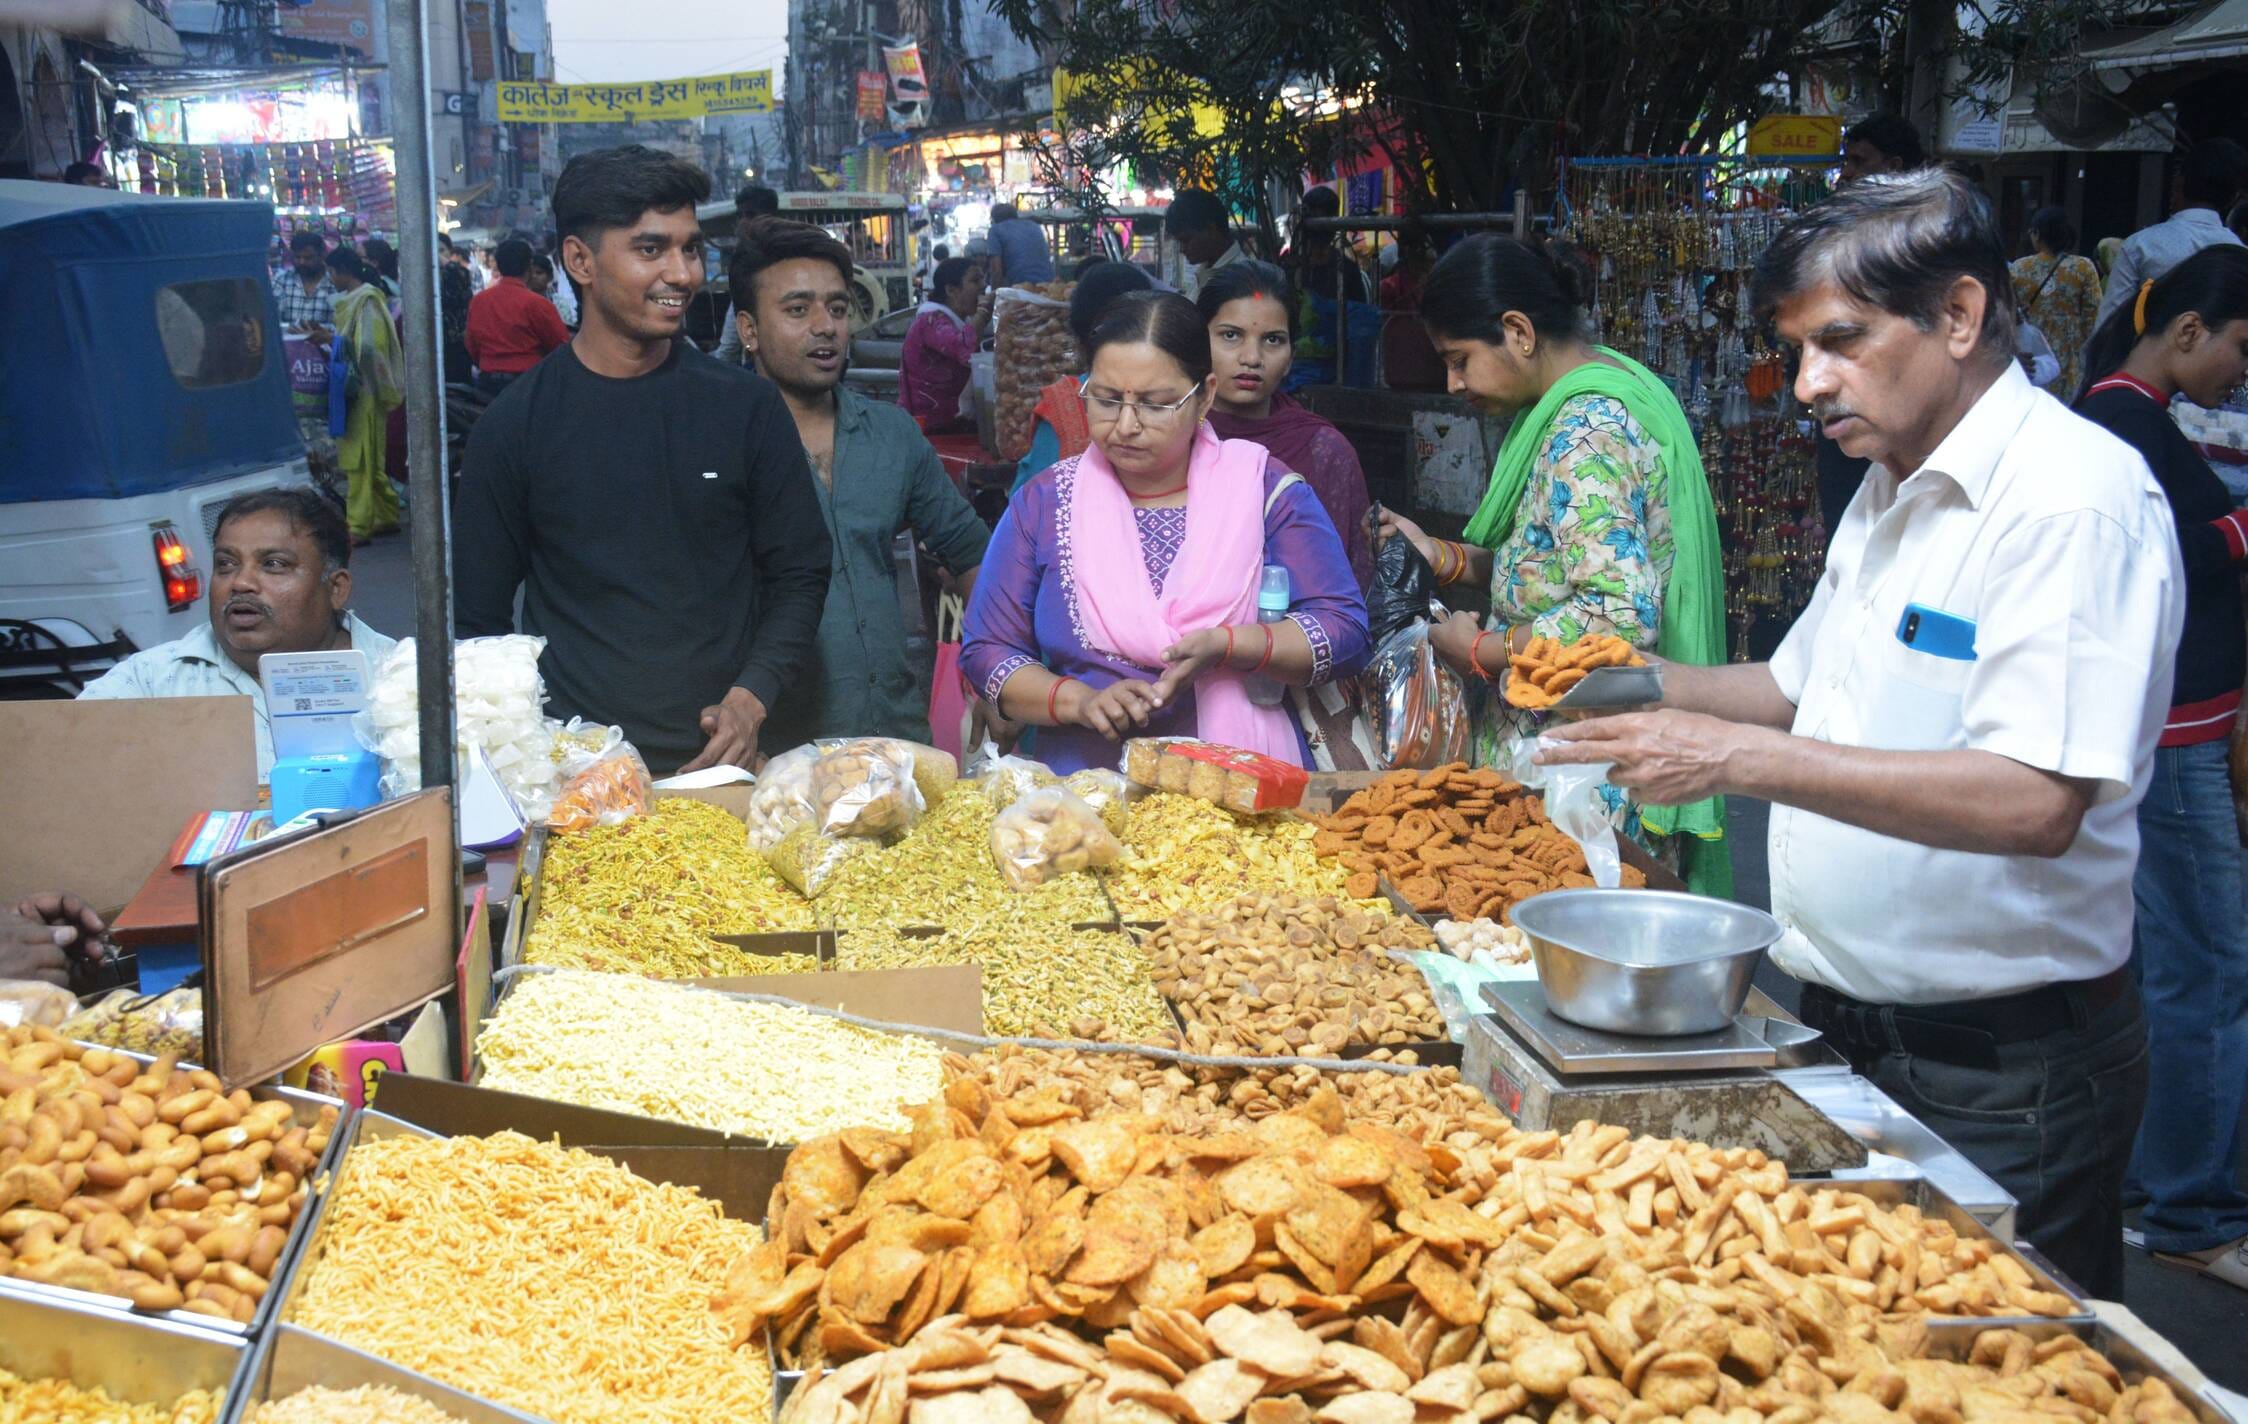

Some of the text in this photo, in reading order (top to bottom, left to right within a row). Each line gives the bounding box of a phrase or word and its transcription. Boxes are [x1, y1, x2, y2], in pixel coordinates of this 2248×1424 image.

[585, 85, 643, 111] स्कूल
[649, 81, 688, 107] ड्रेस
[1771, 134, 1818, 150] SALE
